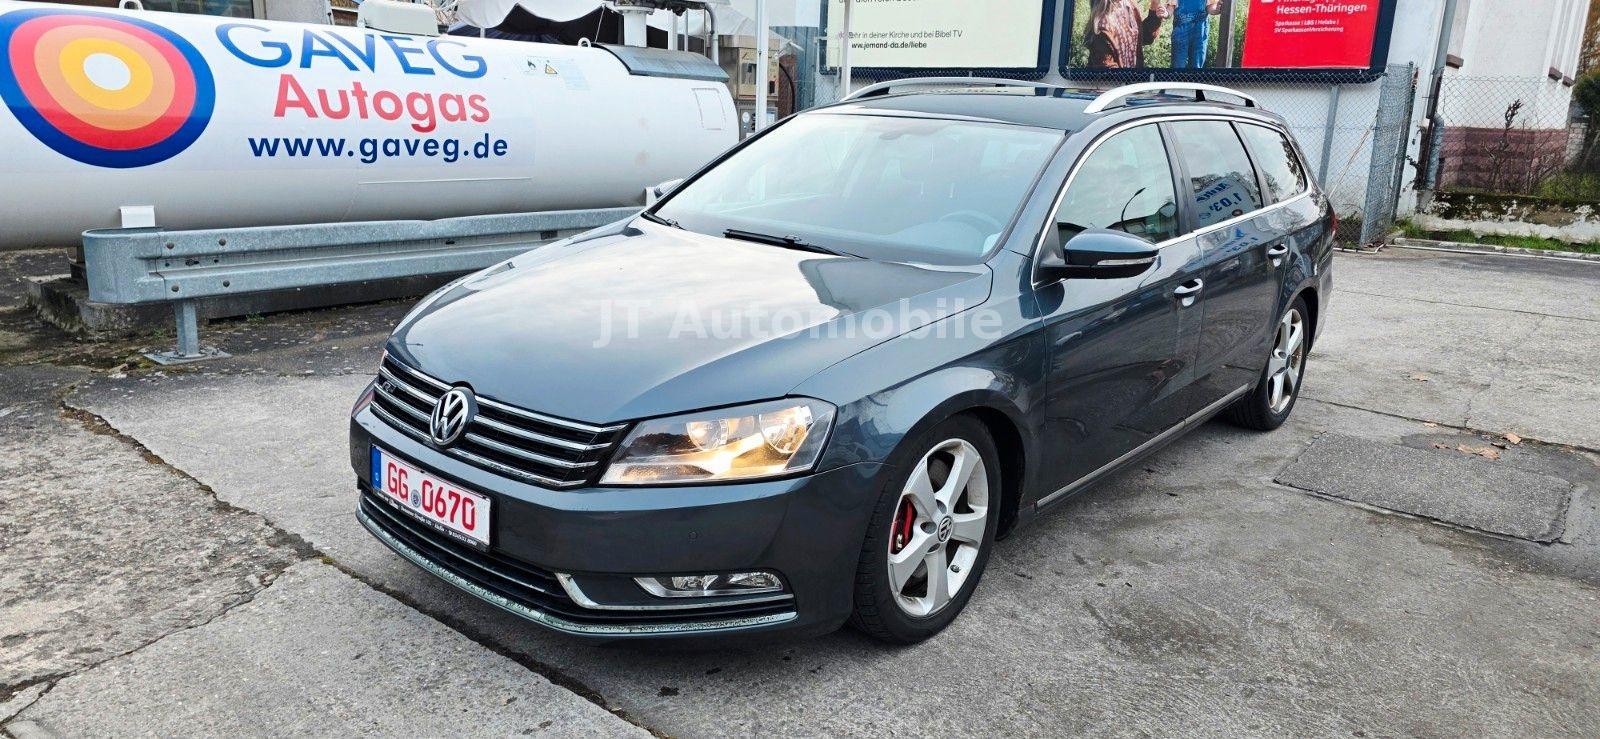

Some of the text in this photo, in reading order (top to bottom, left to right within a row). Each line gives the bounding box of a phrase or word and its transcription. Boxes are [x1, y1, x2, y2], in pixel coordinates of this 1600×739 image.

[1276, 3, 1367, 14] Hessen-Thüringen
[215, 23, 488, 79] GAVEG
[953, 29, 963, 37] TV
[273, 74, 490, 133] Autogas
[248, 133, 508, 164] www.gaveg.de
[387, 461, 409, 502] GG
[421, 479, 476, 532] 0670
